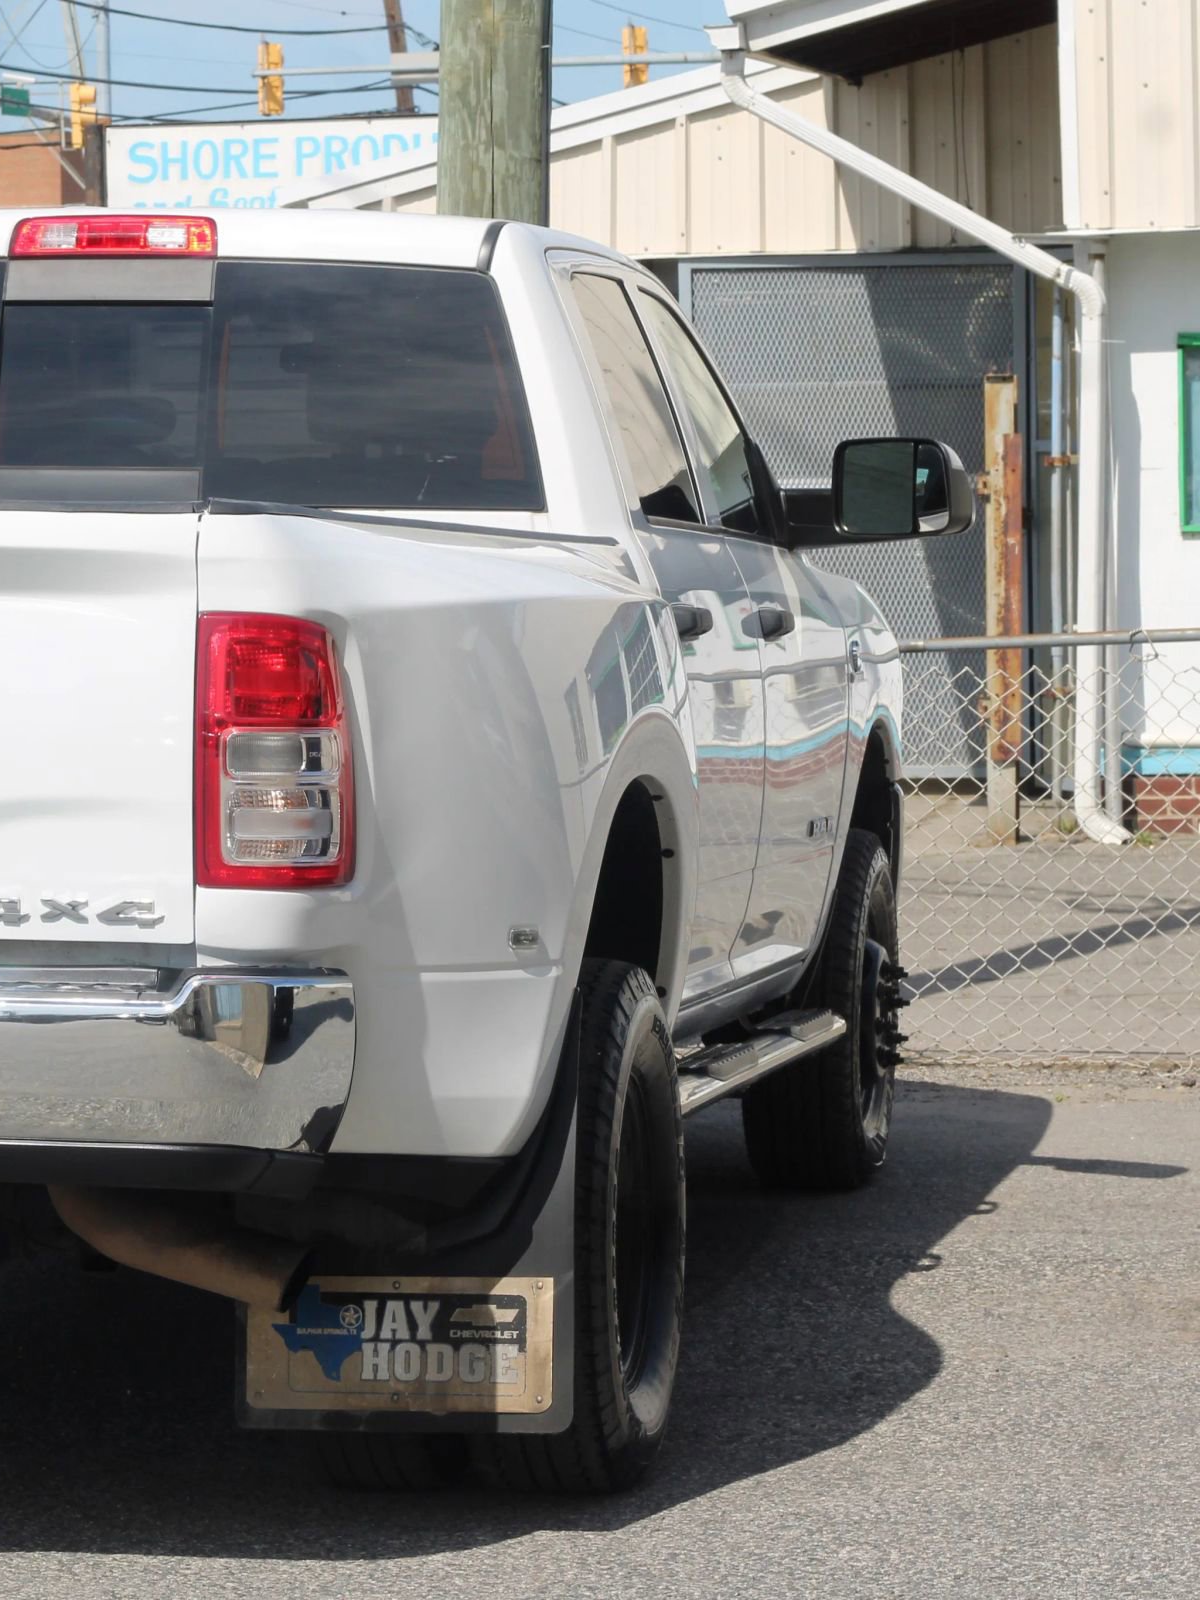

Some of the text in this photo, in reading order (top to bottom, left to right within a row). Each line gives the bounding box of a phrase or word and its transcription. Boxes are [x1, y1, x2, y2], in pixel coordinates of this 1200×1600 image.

[127, 132, 439, 185] SHORE PROD
[360, 1299, 441, 1341] JAY
[450, 1329, 519, 1339] CHEVROLET
[361, 1341, 519, 1384] HODGE
